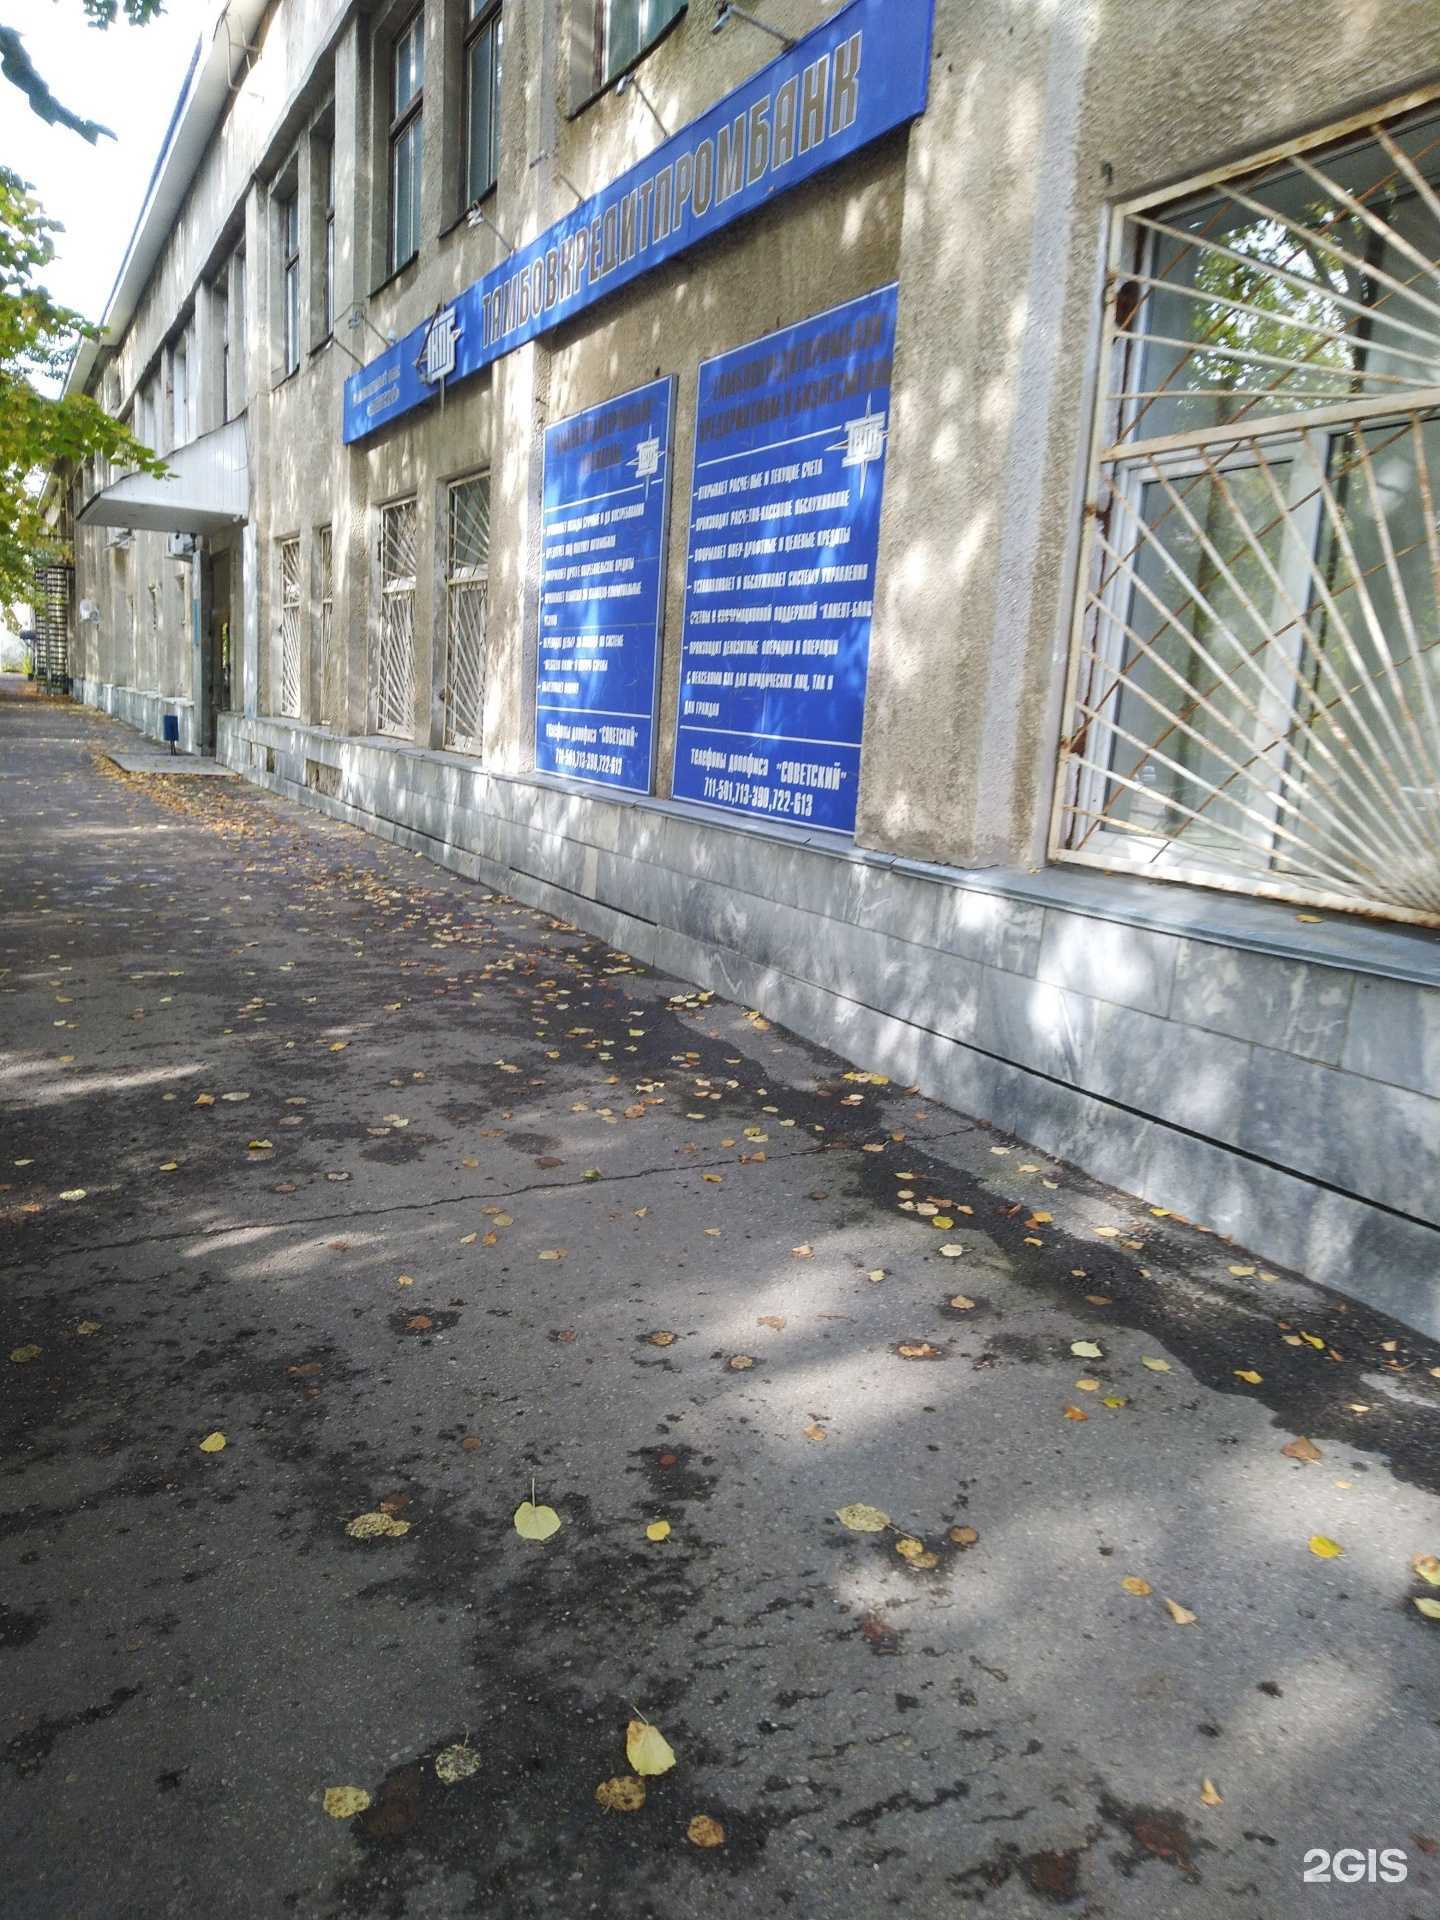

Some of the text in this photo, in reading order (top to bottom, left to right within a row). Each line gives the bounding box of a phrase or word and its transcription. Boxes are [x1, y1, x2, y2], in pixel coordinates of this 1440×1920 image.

[481, 30, 862, 349] ТАМБОВКРЕДИТПРОМБАНК
[763, 470, 769, 486] И
[801, 458, 823, 479] СЧЕТА
[778, 536, 784, 552] И
[826, 675, 834, 691] И
[690, 747, 727, 772] телефоны
